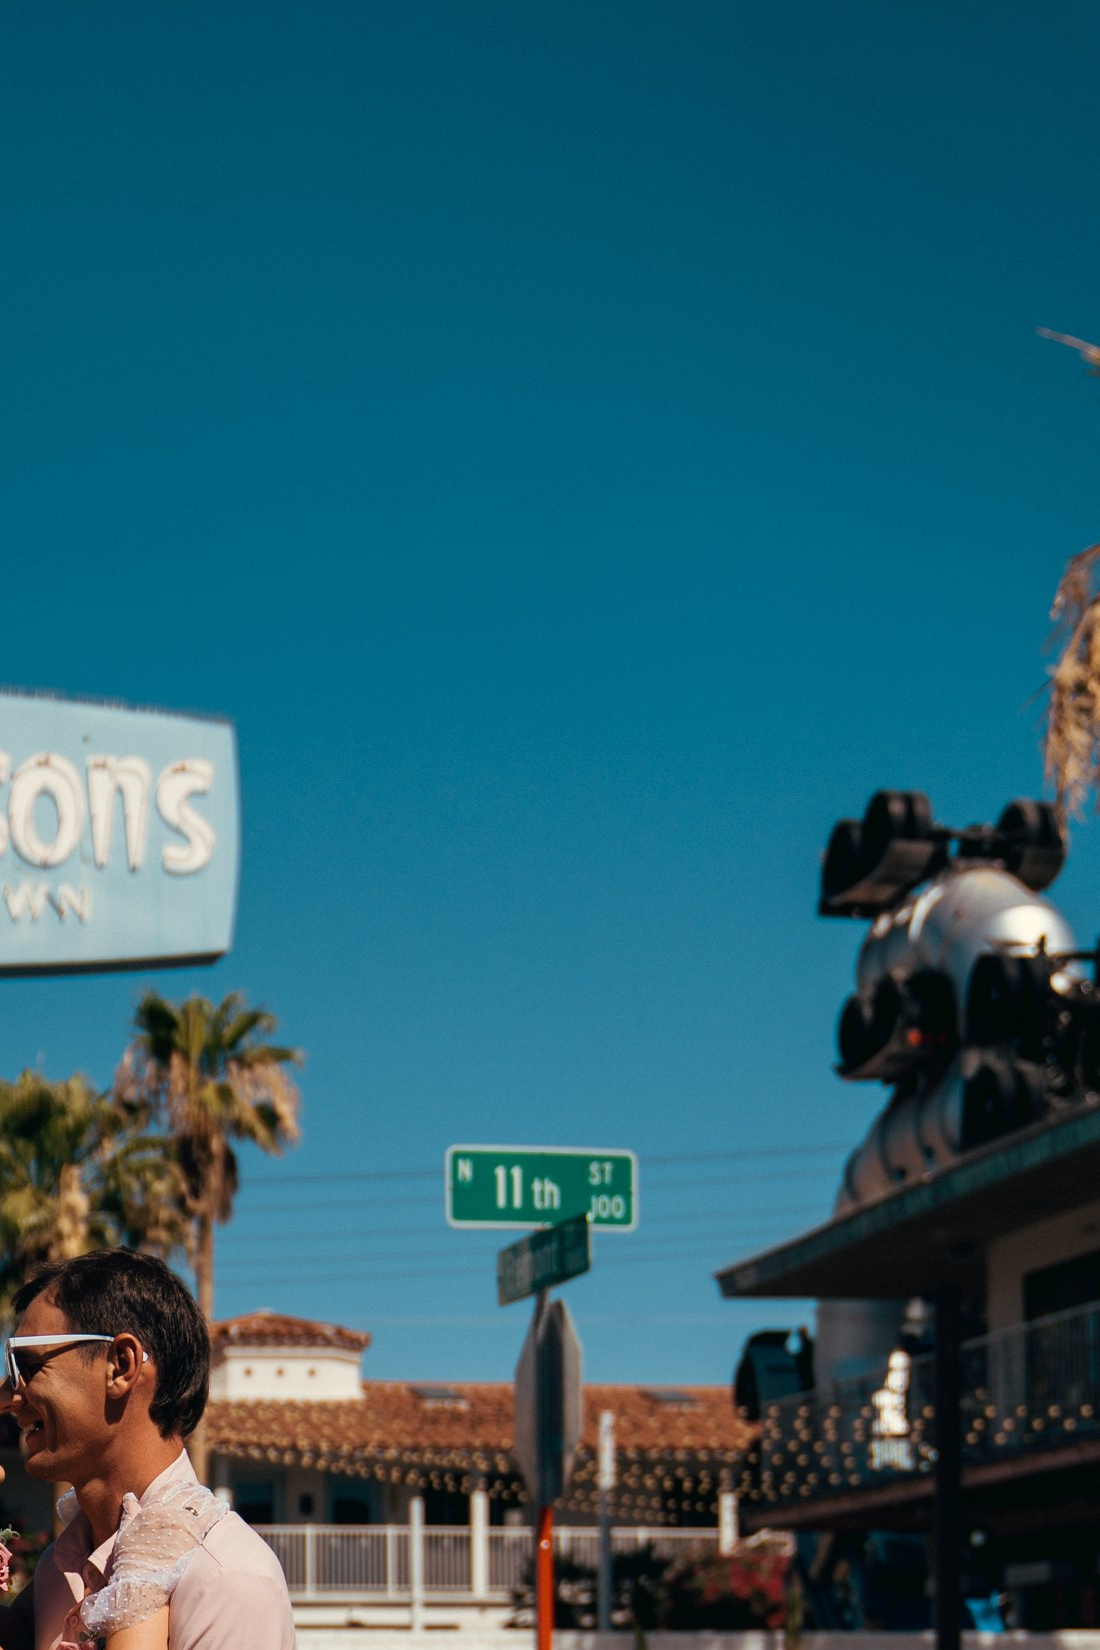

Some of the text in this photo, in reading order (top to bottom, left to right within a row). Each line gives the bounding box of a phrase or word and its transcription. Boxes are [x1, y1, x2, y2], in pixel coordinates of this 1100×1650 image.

[457, 1158, 613, 1210] N 11th ST
